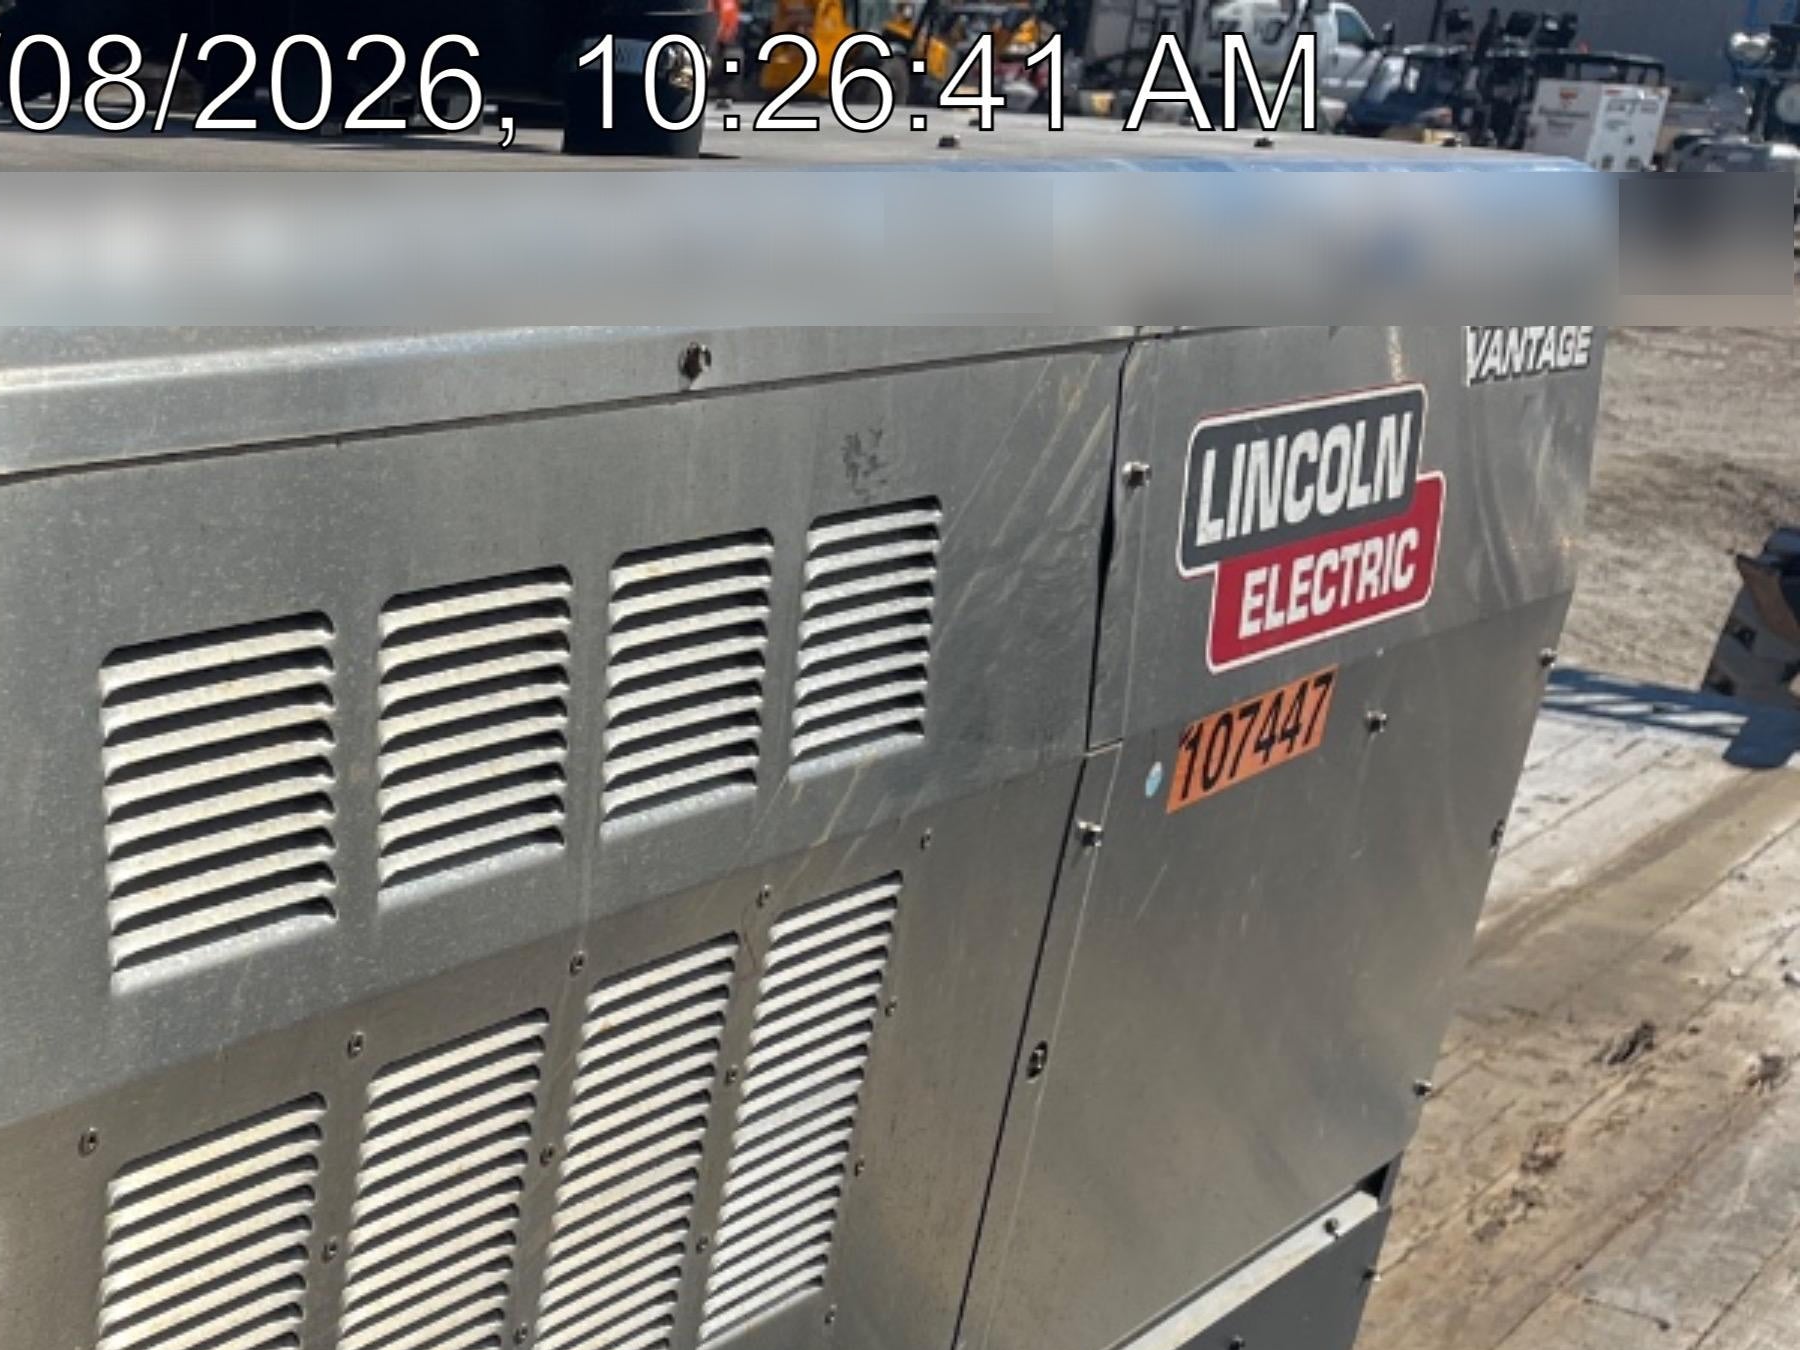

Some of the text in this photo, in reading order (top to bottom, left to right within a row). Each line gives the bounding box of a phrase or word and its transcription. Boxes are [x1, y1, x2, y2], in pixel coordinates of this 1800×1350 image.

[1465, 326, 1593, 382] VANTAGE
[1195, 411, 1414, 546] LINCOLN
[1238, 526, 1420, 640] ELECTRIC
[1179, 674, 1334, 800] 107447
